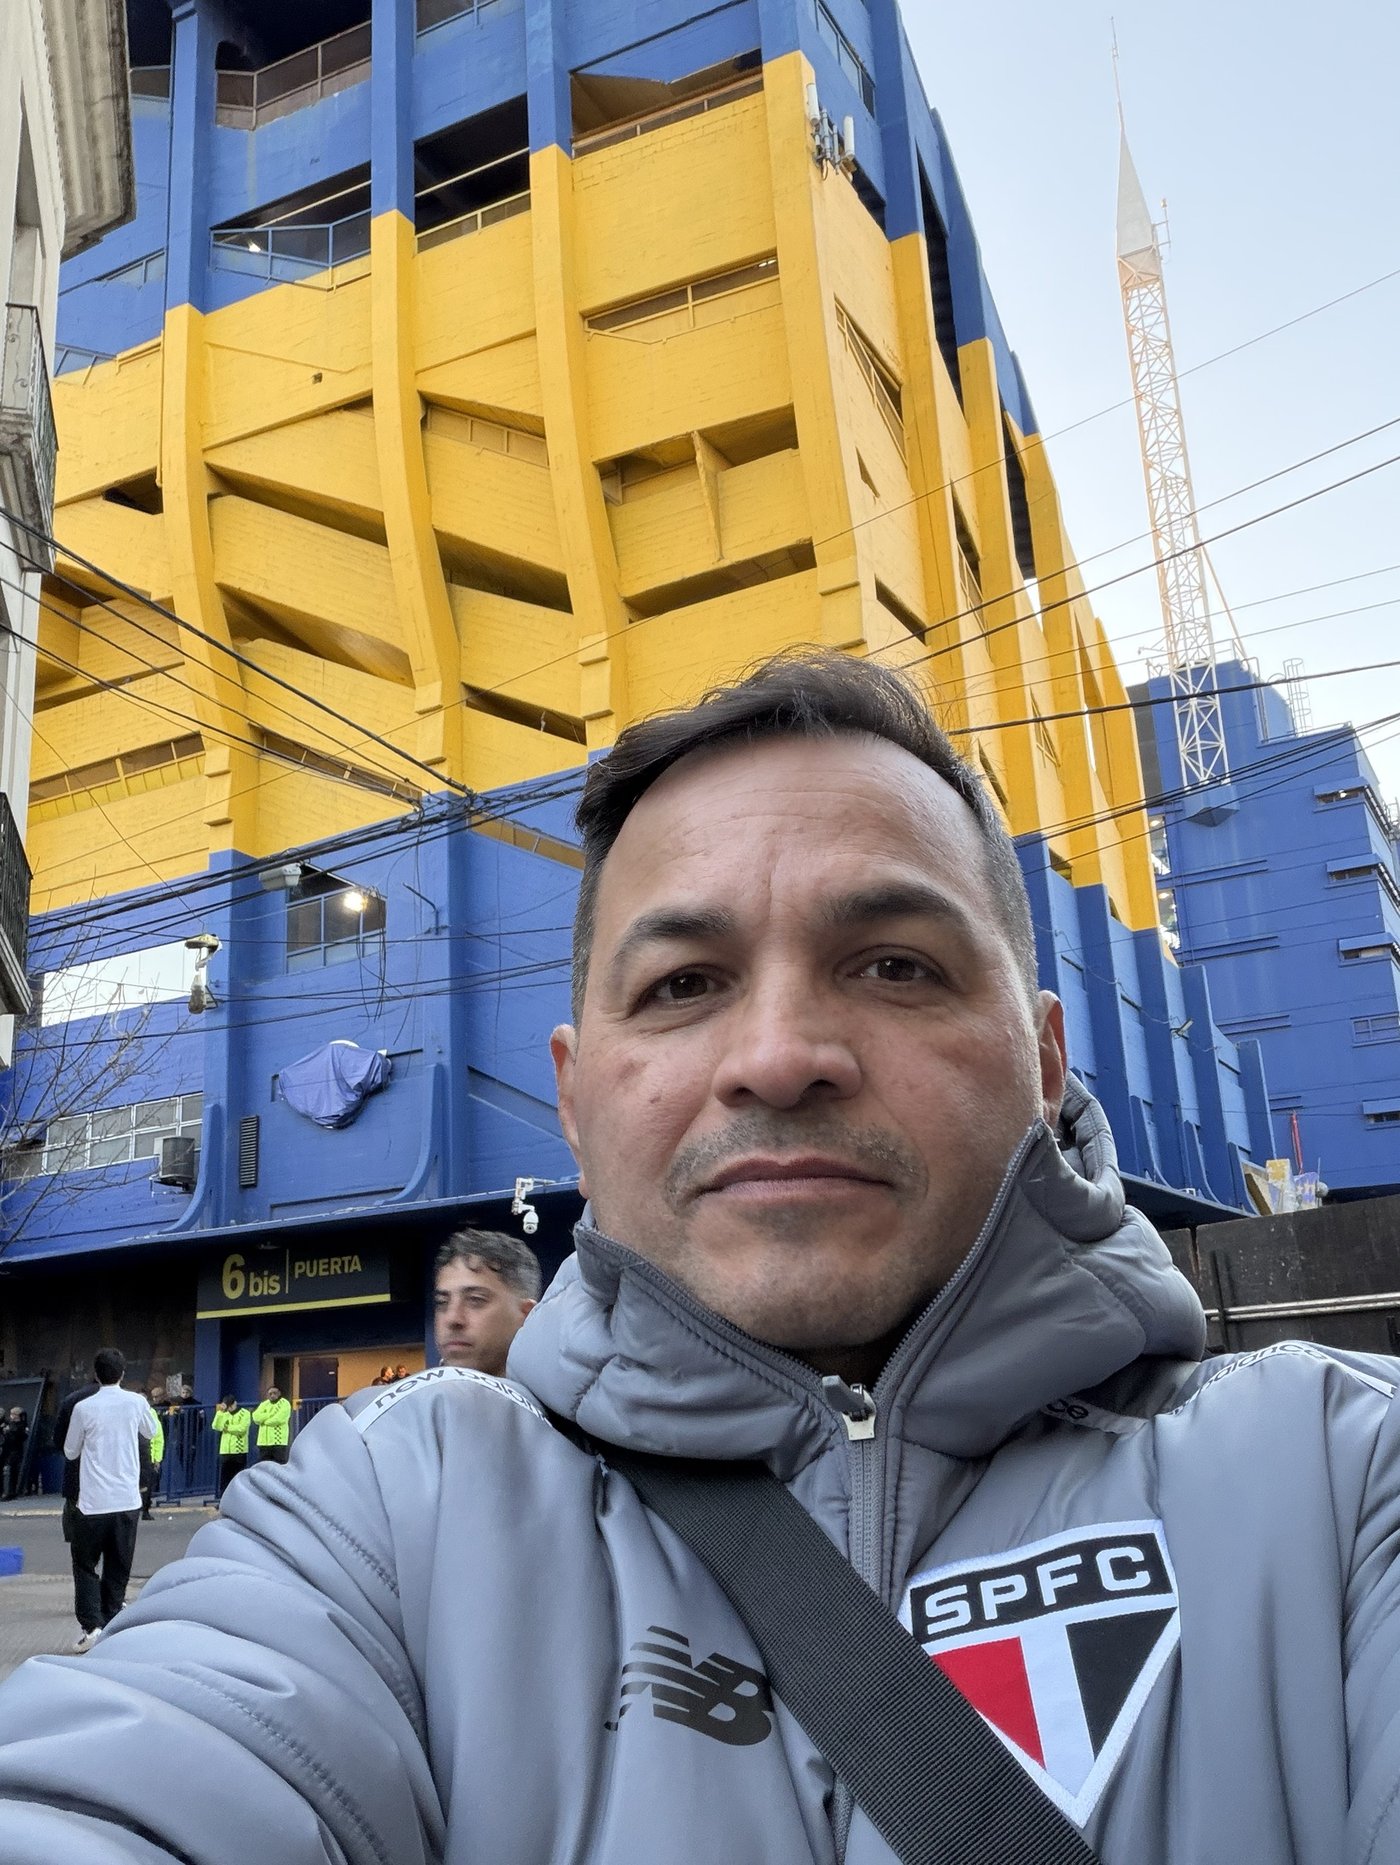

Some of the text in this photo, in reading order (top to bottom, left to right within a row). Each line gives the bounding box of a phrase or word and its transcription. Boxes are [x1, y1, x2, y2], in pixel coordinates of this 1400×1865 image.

[222, 1253, 362, 1300] 6 bis PUERTA
[374, 1369, 445, 1409] new
[925, 1546, 1151, 1635] SPFC
